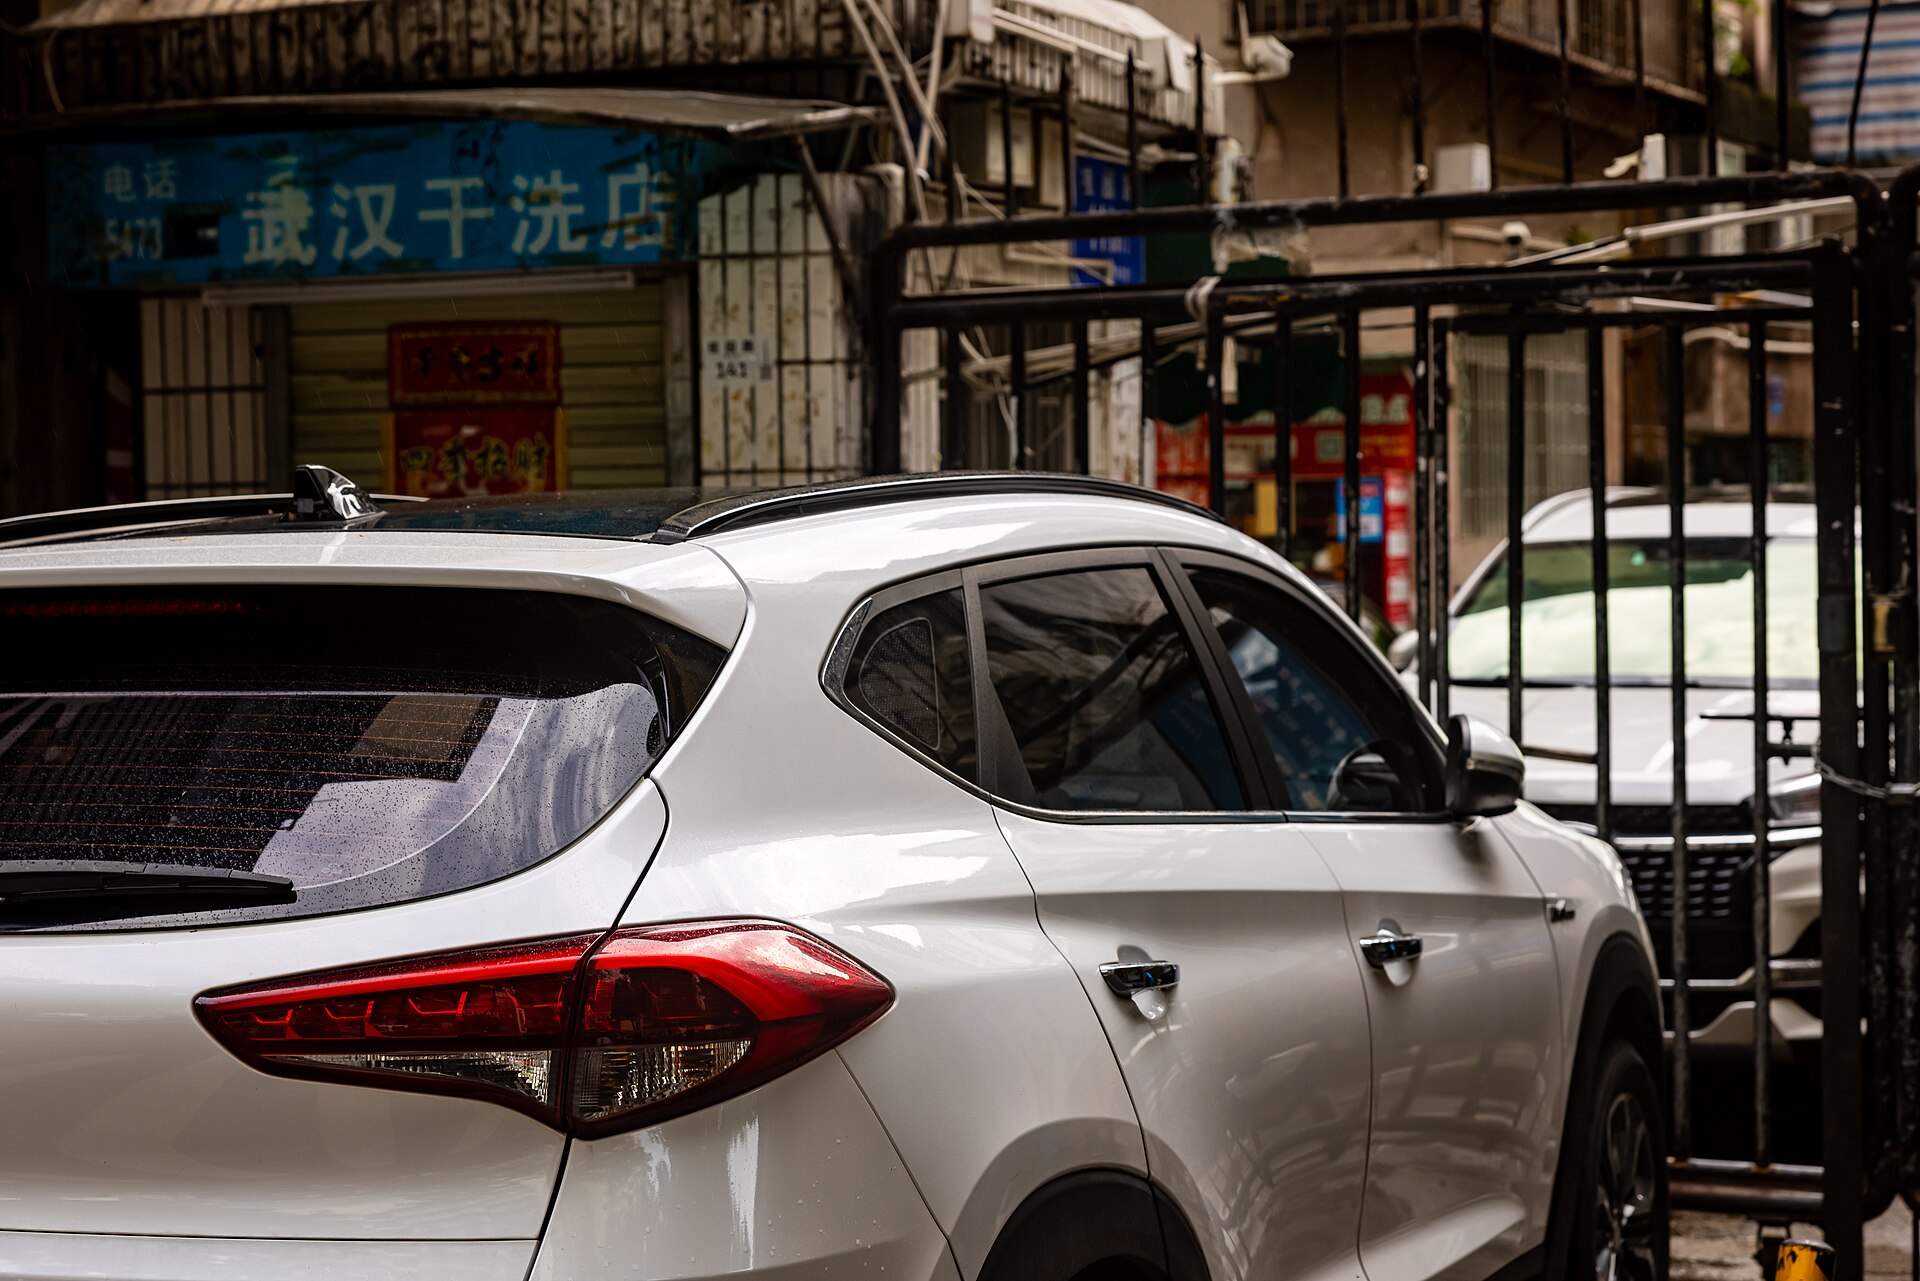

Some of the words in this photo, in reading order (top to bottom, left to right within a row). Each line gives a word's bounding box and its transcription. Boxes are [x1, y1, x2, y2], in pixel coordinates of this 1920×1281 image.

[103, 160, 177, 203] 电话
[241, 158, 678, 267] 武汉干洗店
